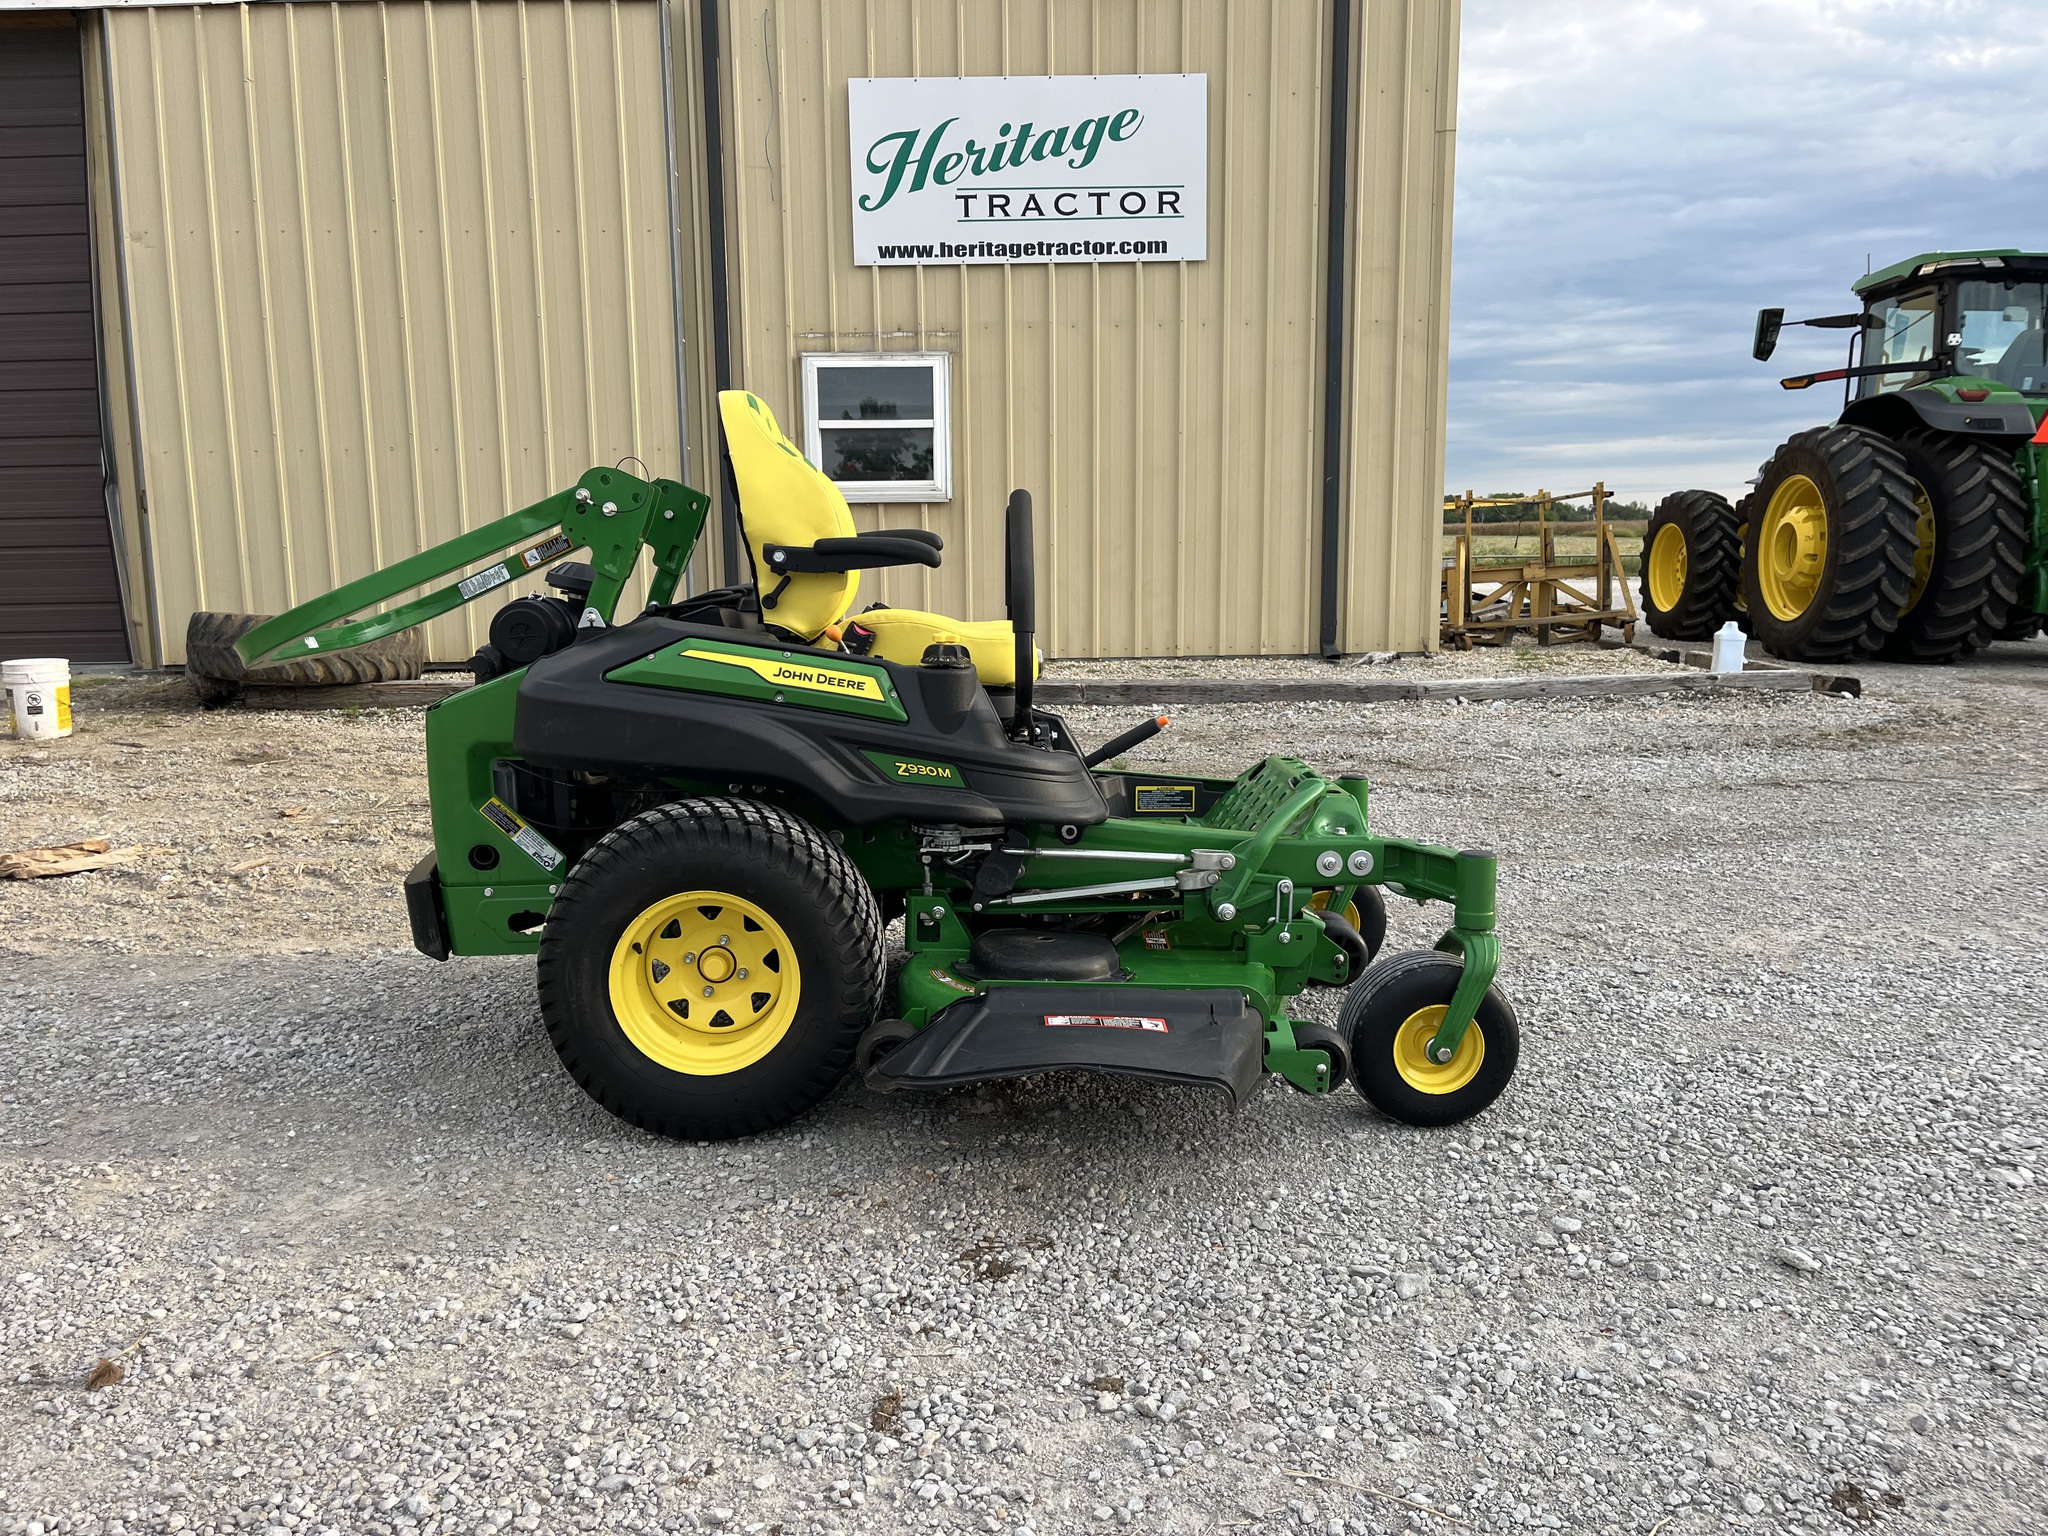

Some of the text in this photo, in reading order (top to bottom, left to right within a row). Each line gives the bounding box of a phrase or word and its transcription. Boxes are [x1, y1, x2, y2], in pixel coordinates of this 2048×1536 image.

[858, 108, 1145, 212] Heritage
[955, 191, 1182, 218] TRACTOR
[877, 240, 1168, 259] www.heritagetractor.com
[773, 667, 866, 691] JOHN DEERE
[895, 762, 952, 778] Z930M
